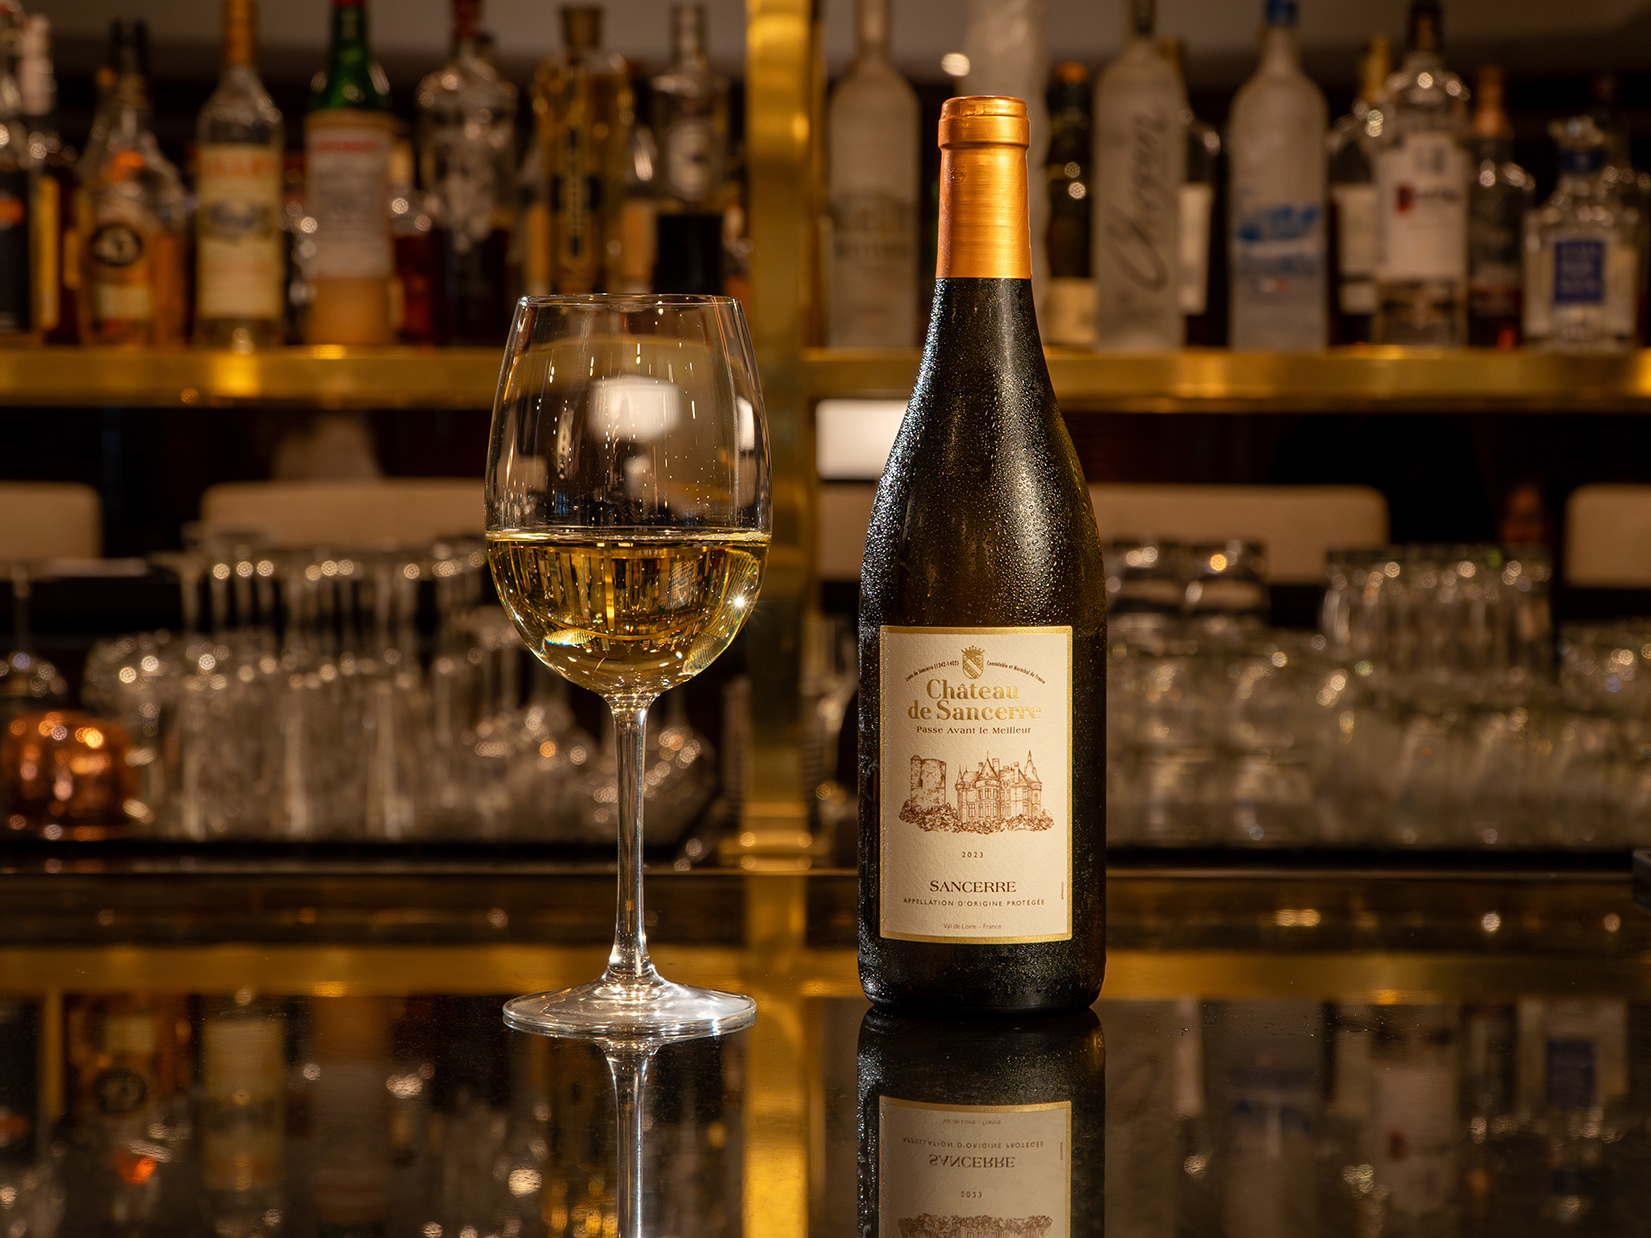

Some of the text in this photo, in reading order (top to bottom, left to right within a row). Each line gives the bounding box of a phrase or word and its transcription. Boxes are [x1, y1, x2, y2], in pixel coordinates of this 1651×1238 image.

[926, 679, 1020, 700] Château
[907, 700, 1042, 721] de Sancerre
[916, 726, 1032, 735] Passe Avant le Meilleur
[961, 851, 985, 859] 2023
[929, 880, 1017, 893] SANCERRE
[903, 898, 954, 907] APPELLATION
[1006, 898, 1045, 907] PROTÉGÉE
